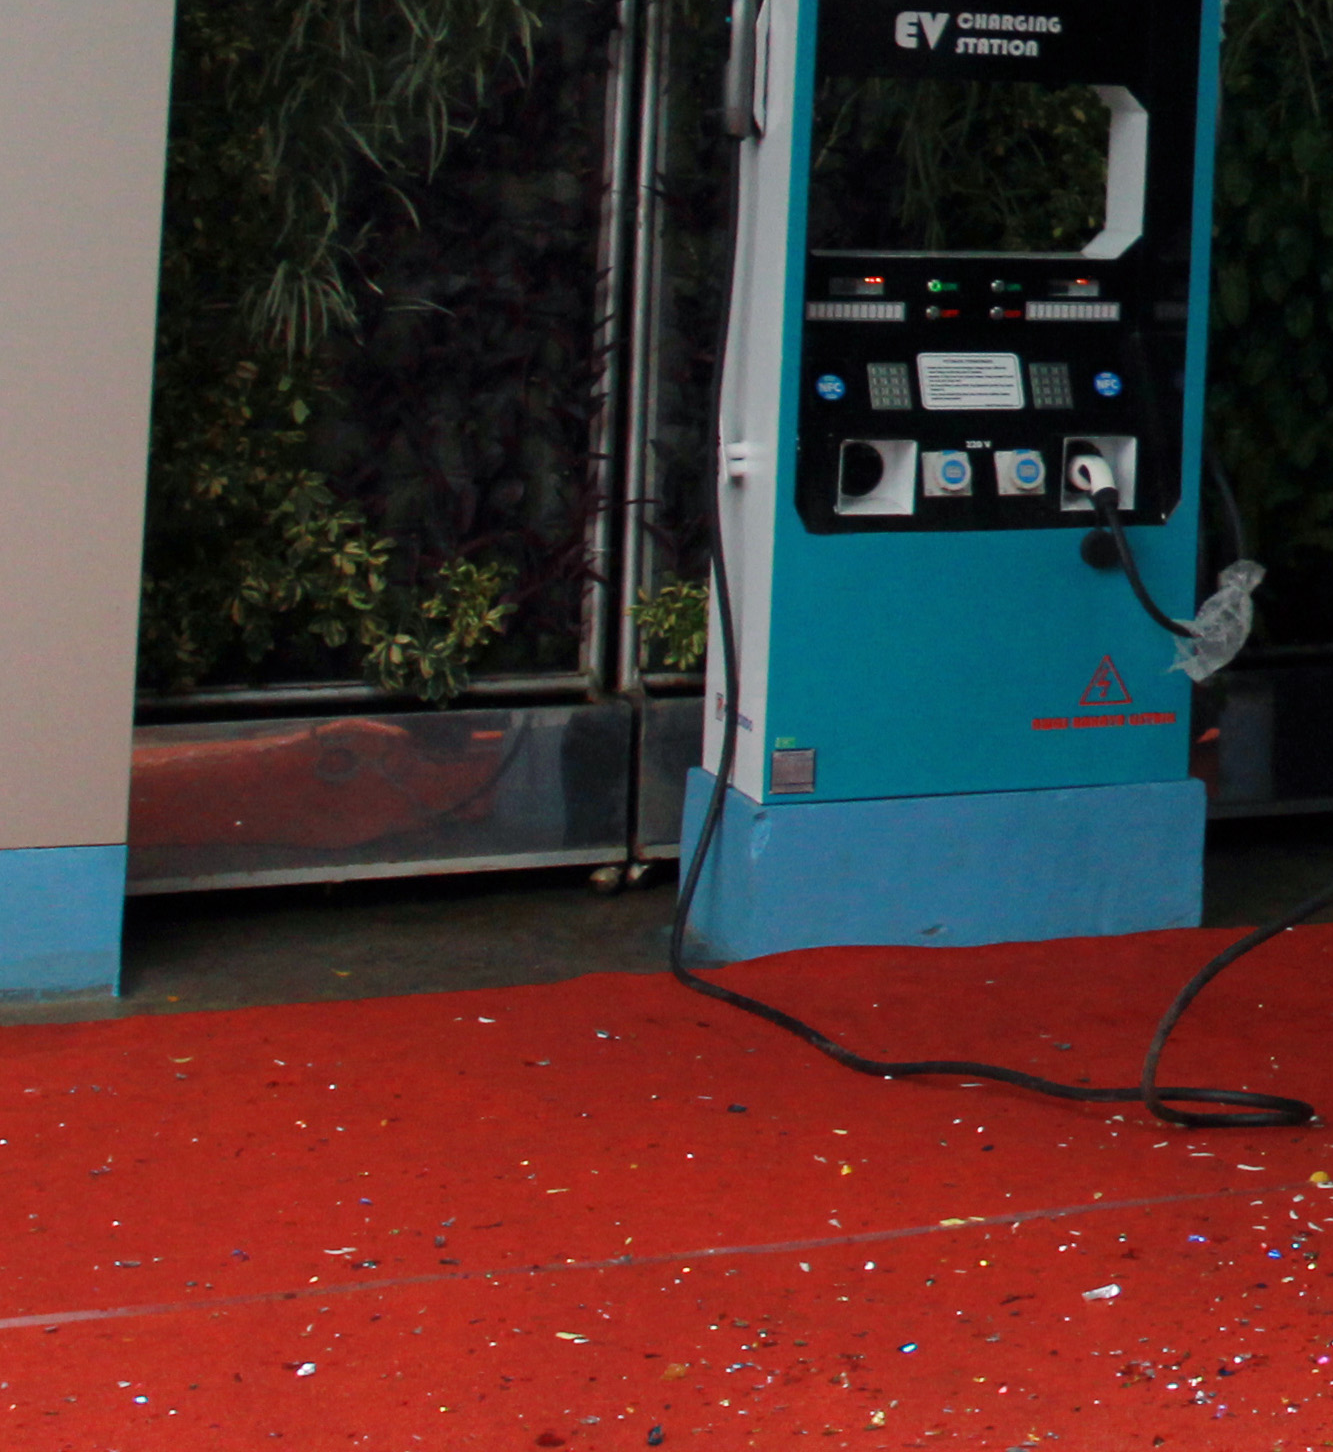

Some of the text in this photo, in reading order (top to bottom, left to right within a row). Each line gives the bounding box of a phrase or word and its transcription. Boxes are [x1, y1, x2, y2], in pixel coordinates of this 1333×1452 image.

[895, 11, 1062, 50] EV CHARGING
[955, 37, 1039, 57] STATION
